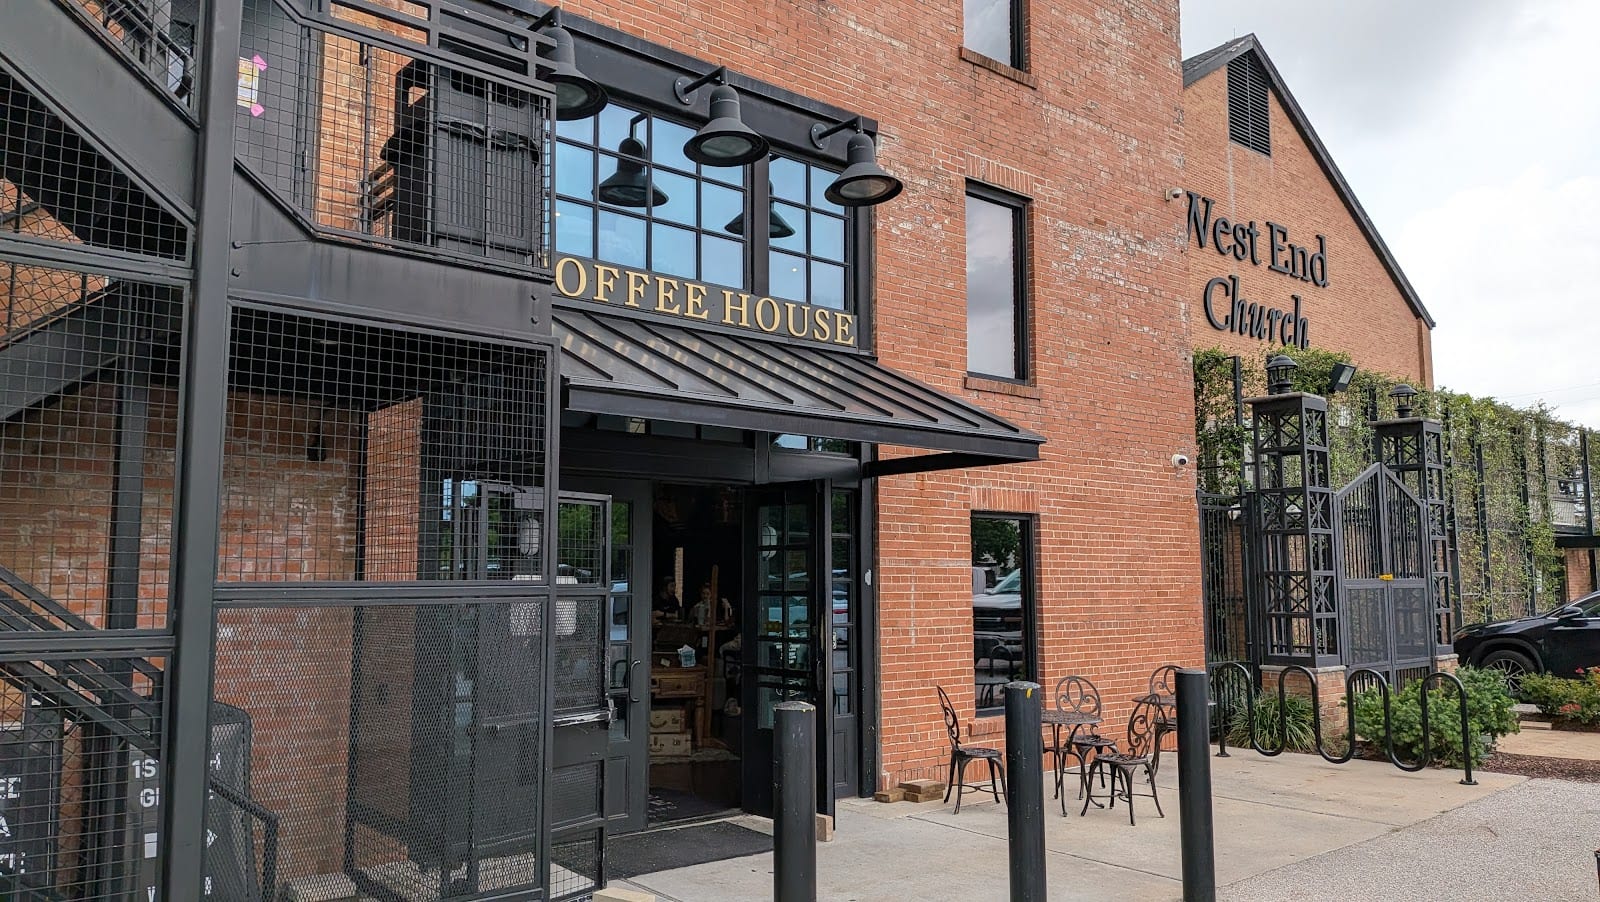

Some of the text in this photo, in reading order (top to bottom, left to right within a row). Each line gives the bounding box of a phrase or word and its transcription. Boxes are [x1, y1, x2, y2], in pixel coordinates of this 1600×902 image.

[1266, 221, 1329, 288] End
[544, 253, 855, 345] OFFEE HOUSE
[1204, 275, 1309, 351] Church
